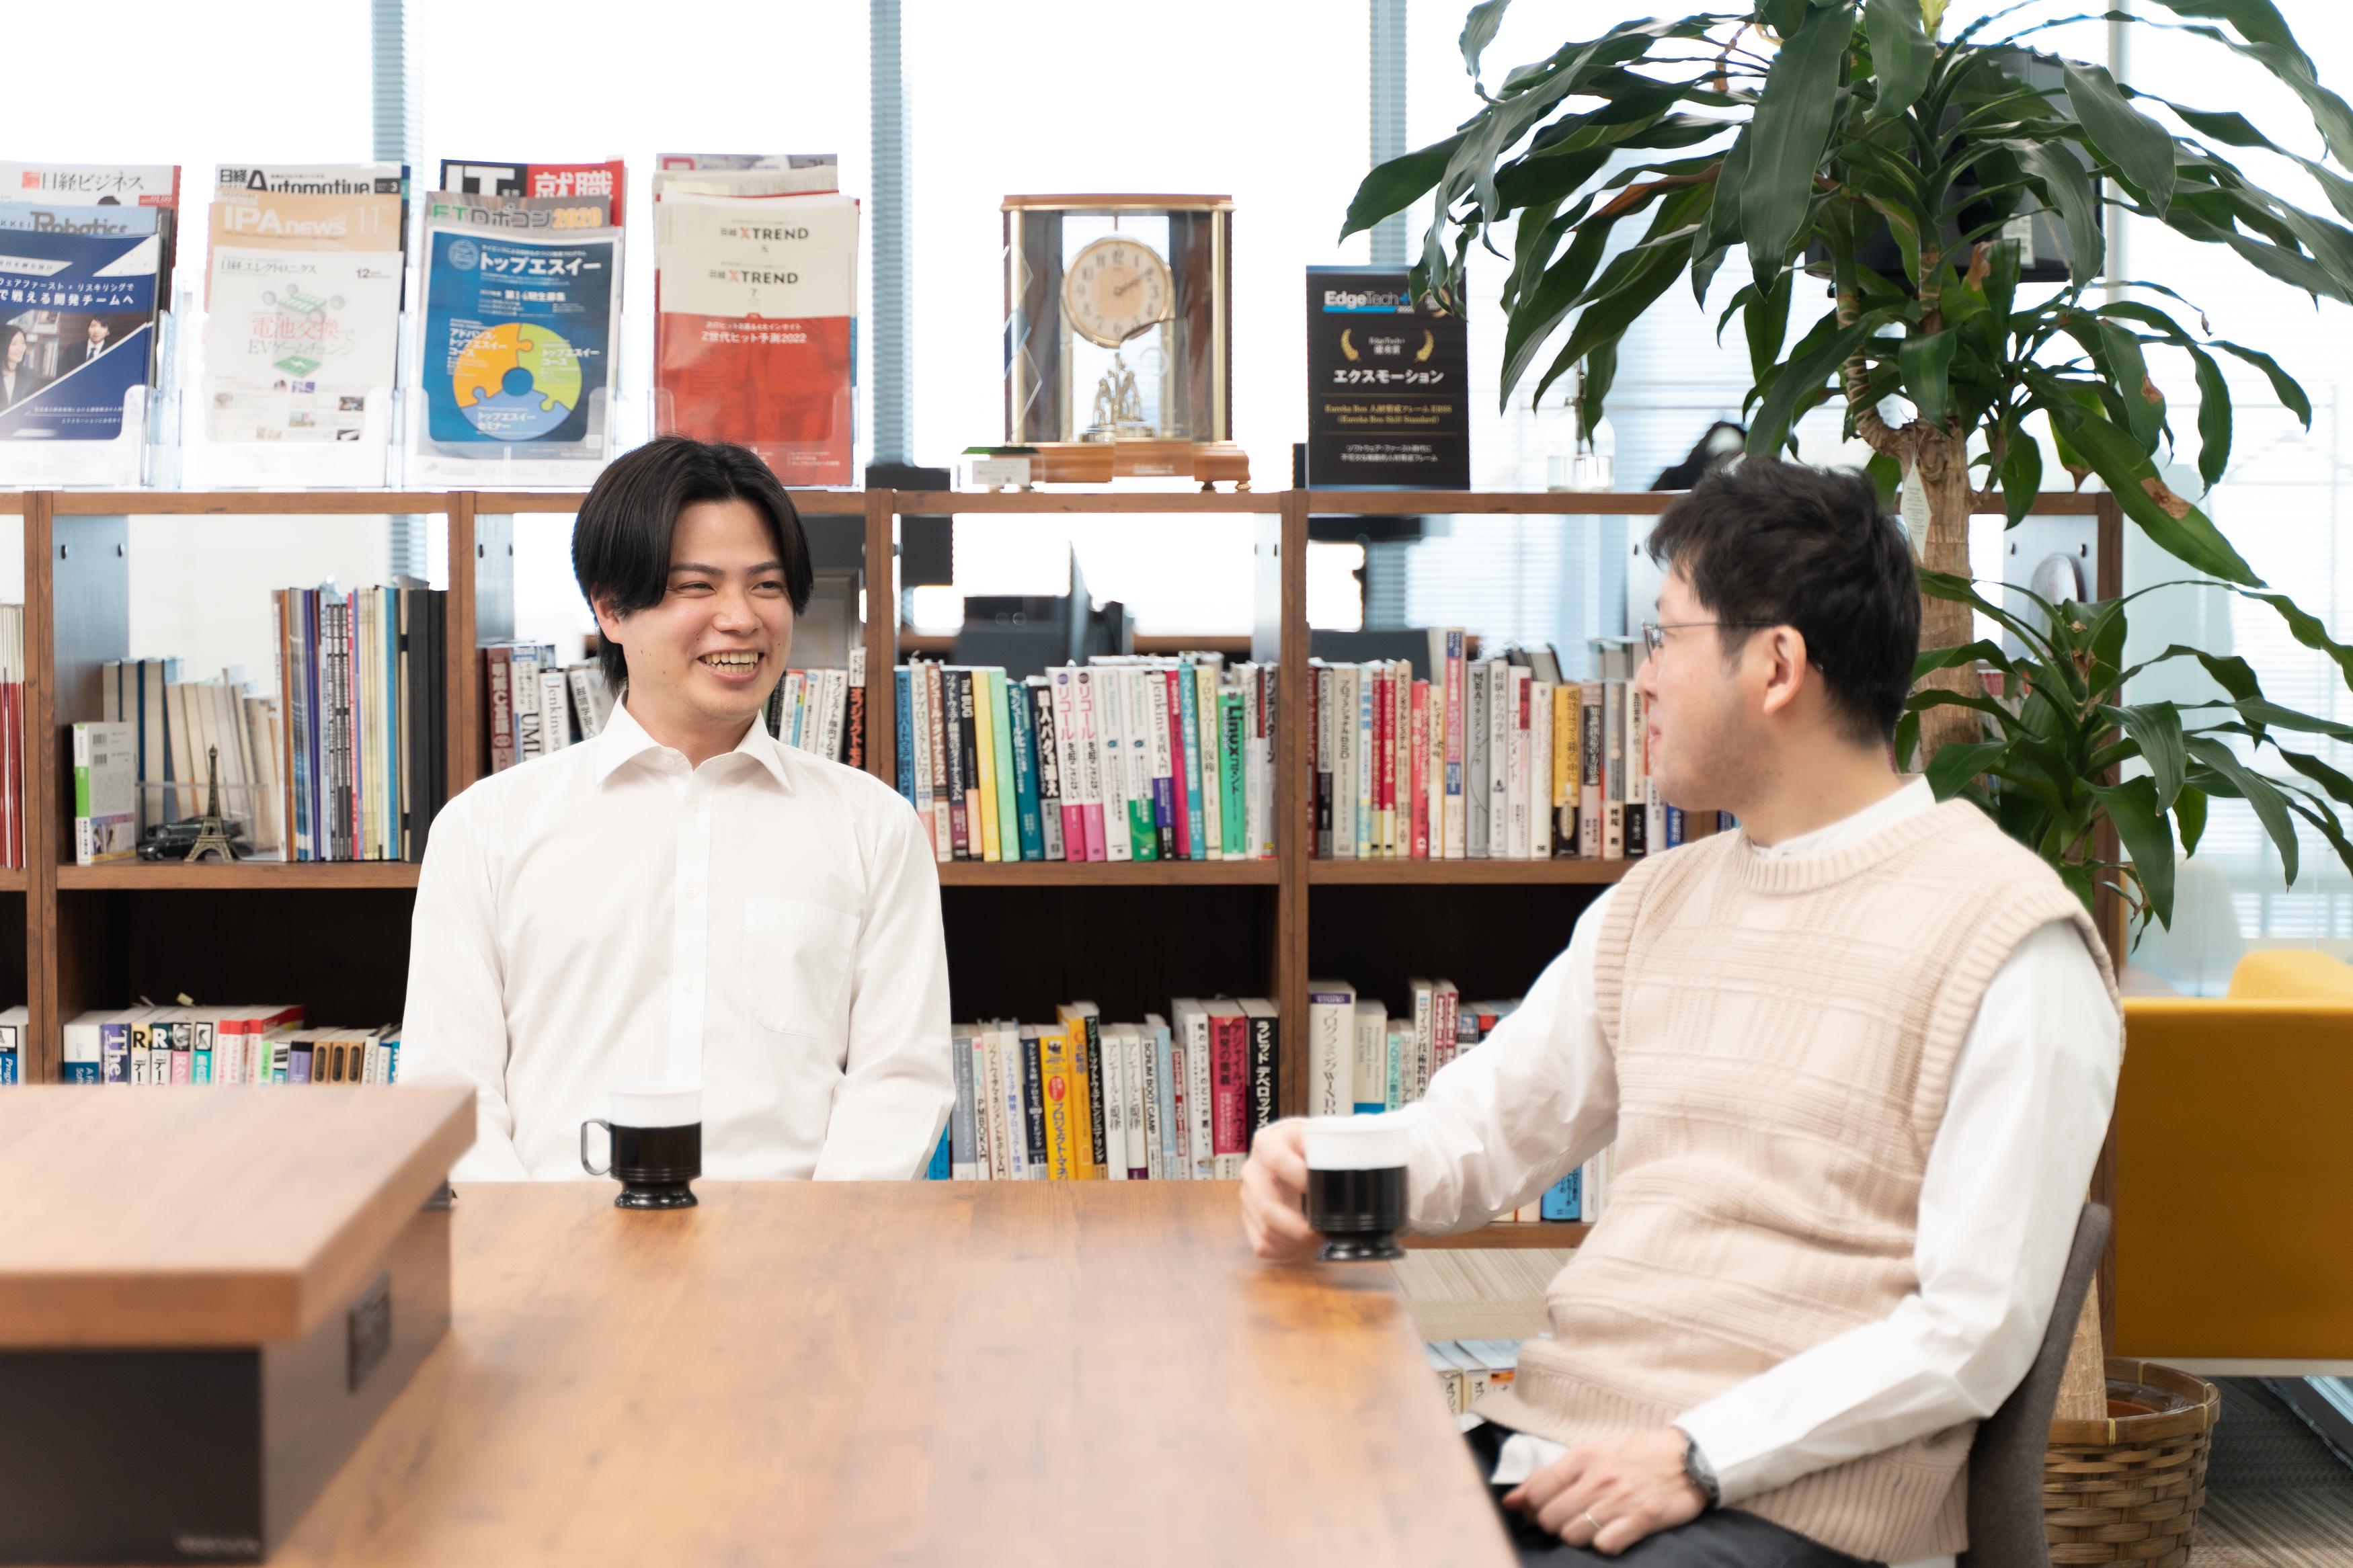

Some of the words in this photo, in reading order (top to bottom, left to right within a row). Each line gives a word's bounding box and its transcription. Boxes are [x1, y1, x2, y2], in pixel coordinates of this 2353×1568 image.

[42, 171, 143, 192] 日経ビジネス
[446, 165, 515, 196] IT
[534, 169, 613, 199] 就職
[225, 206, 283, 235] IPA
[356, 268, 370, 279] 12
[480, 252, 602, 276] トップエスイー
[1333, 369, 1445, 384] エクスモーション
[546, 683, 562, 735] Jenkins
[1057, 686, 1076, 739] リコール
[1079, 686, 1096, 739] リコール
[1151, 679, 1168, 733] Jenkins
[1265, 671, 1276, 764] アンチパターン
[1494, 672, 1505, 743] 経験からの学習
[132, 1030, 147, 1048] R
[153, 1027, 169, 1048] R
[1256, 1021, 1271, 1063] ラピッド
[108, 1030, 128, 1077] The
